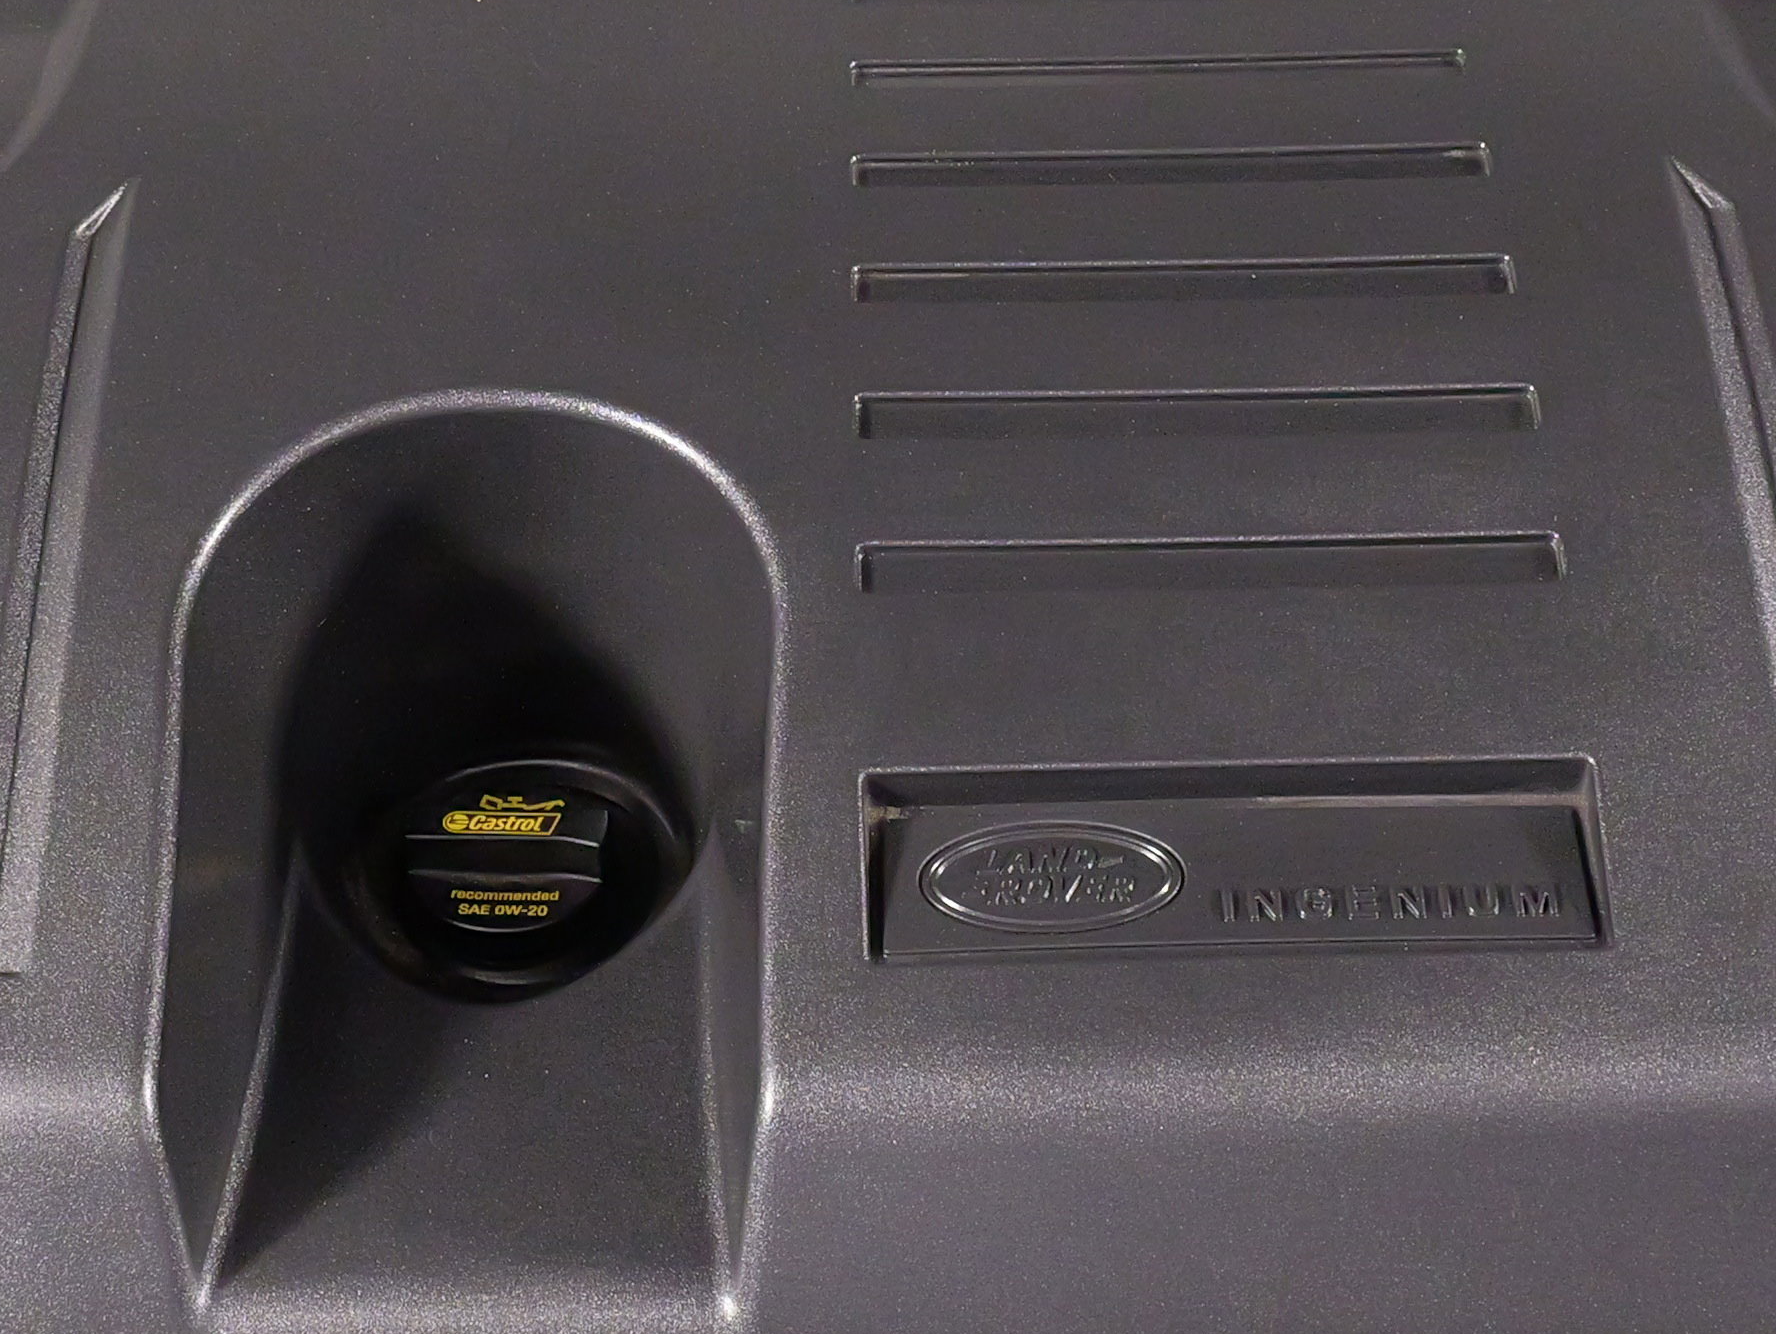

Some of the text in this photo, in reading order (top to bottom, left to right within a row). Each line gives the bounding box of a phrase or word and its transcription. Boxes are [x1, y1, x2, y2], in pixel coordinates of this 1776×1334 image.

[467, 814, 544, 832] Castrol
[450, 888, 560, 902] recommended
[1216, 885, 1565, 921] INGENIUM
[457, 903, 548, 917] SAE 0W-20
